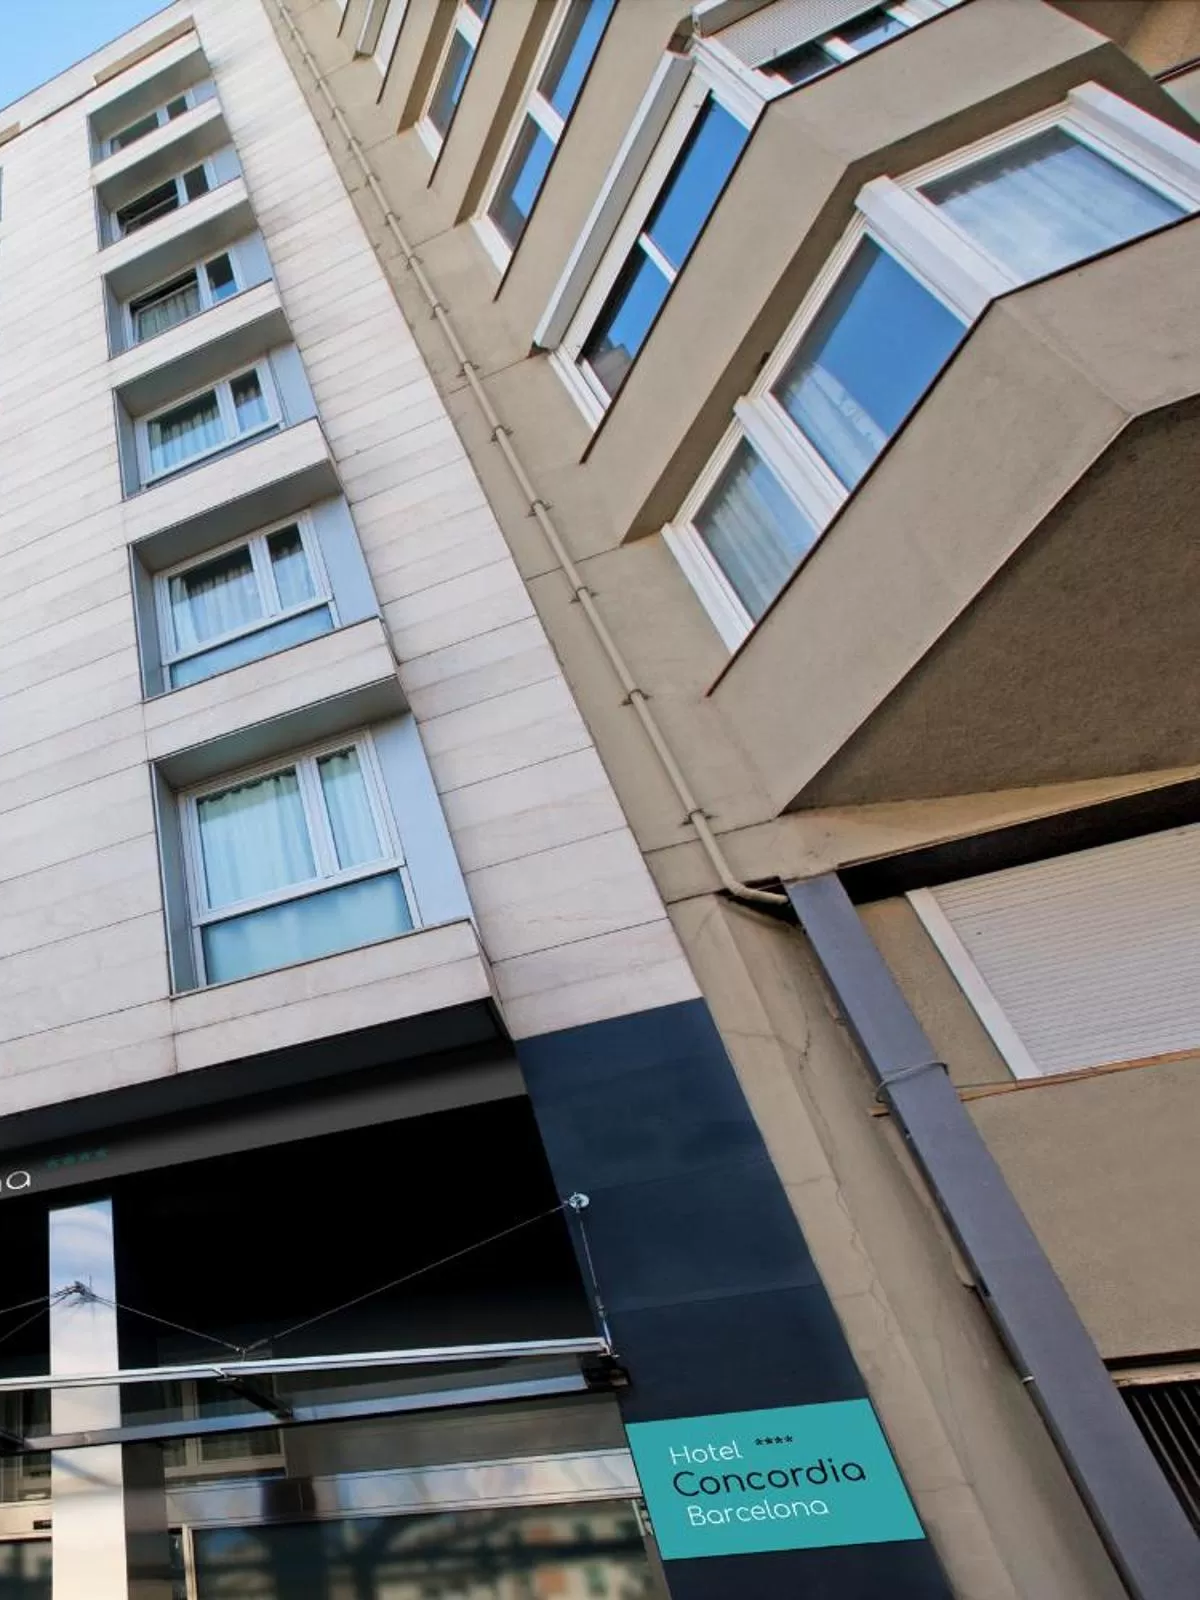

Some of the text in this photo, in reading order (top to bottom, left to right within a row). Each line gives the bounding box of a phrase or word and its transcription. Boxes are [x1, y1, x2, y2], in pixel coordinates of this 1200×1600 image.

[669, 1440, 744, 1466] Hotel
[672, 1457, 867, 1498] Concordia
[686, 1499, 829, 1528] Barcelona
